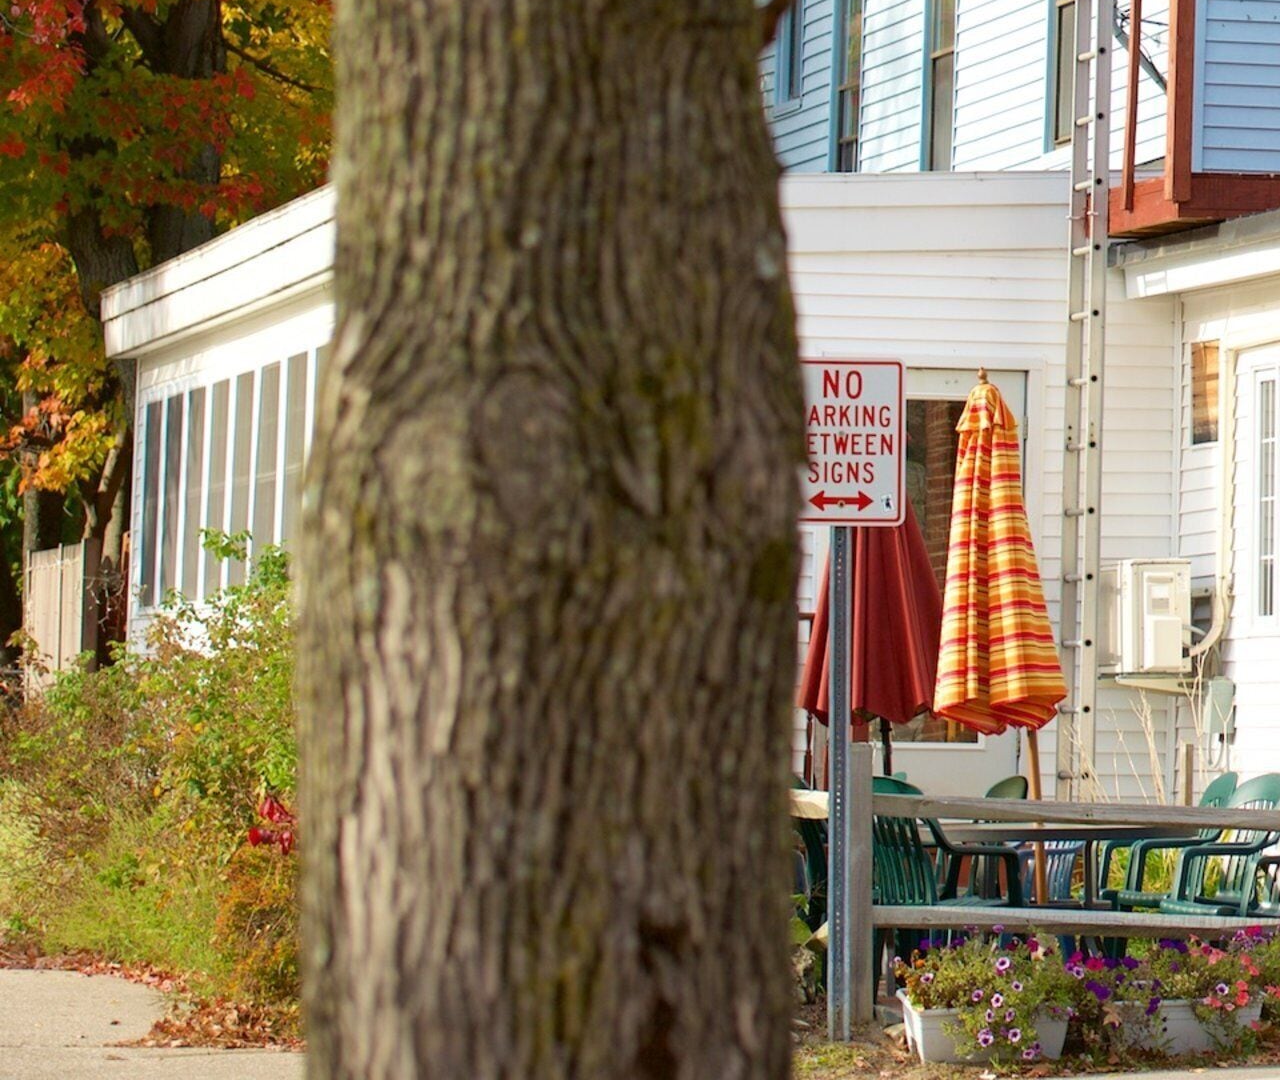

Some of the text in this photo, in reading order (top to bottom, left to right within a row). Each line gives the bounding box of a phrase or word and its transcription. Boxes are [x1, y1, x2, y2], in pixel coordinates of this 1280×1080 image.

[822, 369, 863, 400] NO
[807, 405, 891, 428] ARKING
[806, 433, 894, 456] ETWEEN
[807, 461, 875, 484] SIGNS
